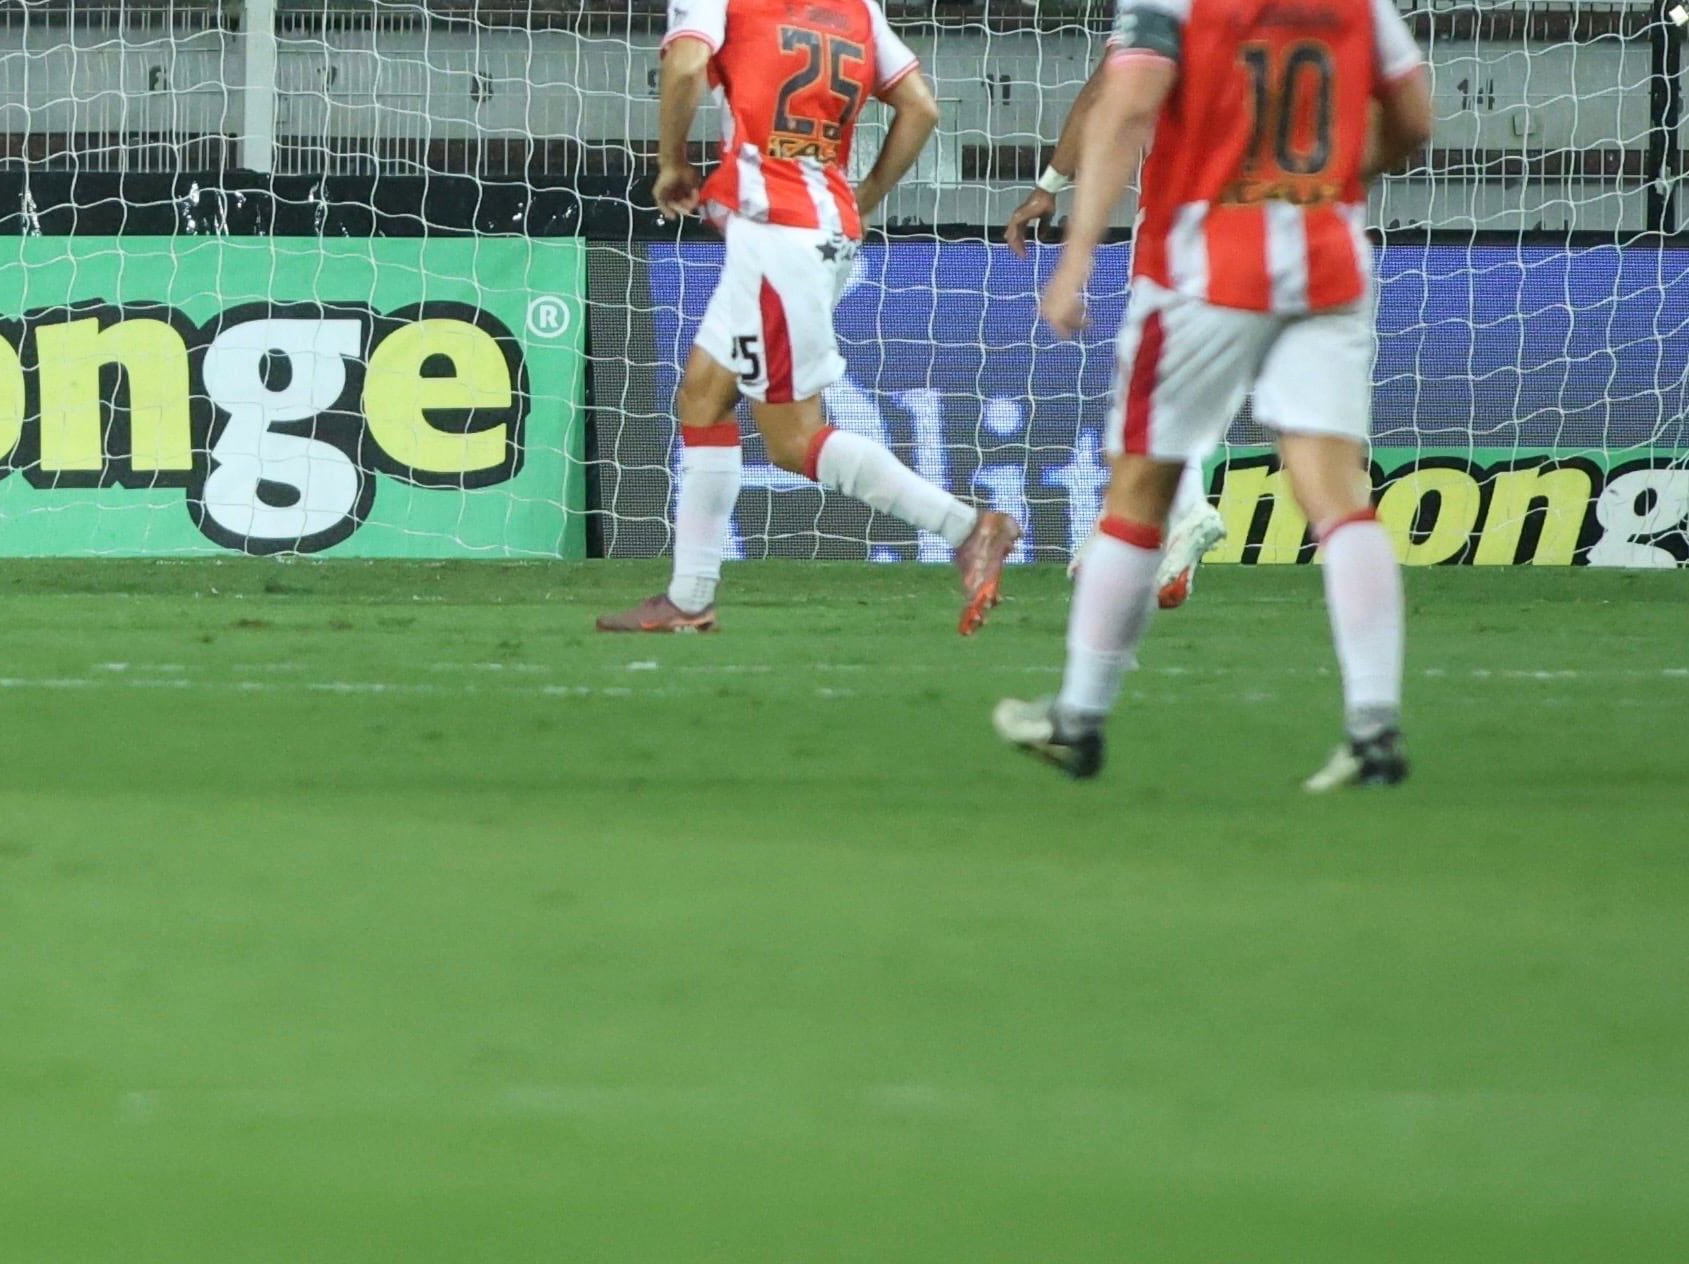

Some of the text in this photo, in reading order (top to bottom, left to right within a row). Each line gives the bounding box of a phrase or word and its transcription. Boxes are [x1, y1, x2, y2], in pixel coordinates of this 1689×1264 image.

[772, 24, 865, 142] 25
[1240, 40, 1335, 175] 10
[1456, 77, 1496, 111] 14
